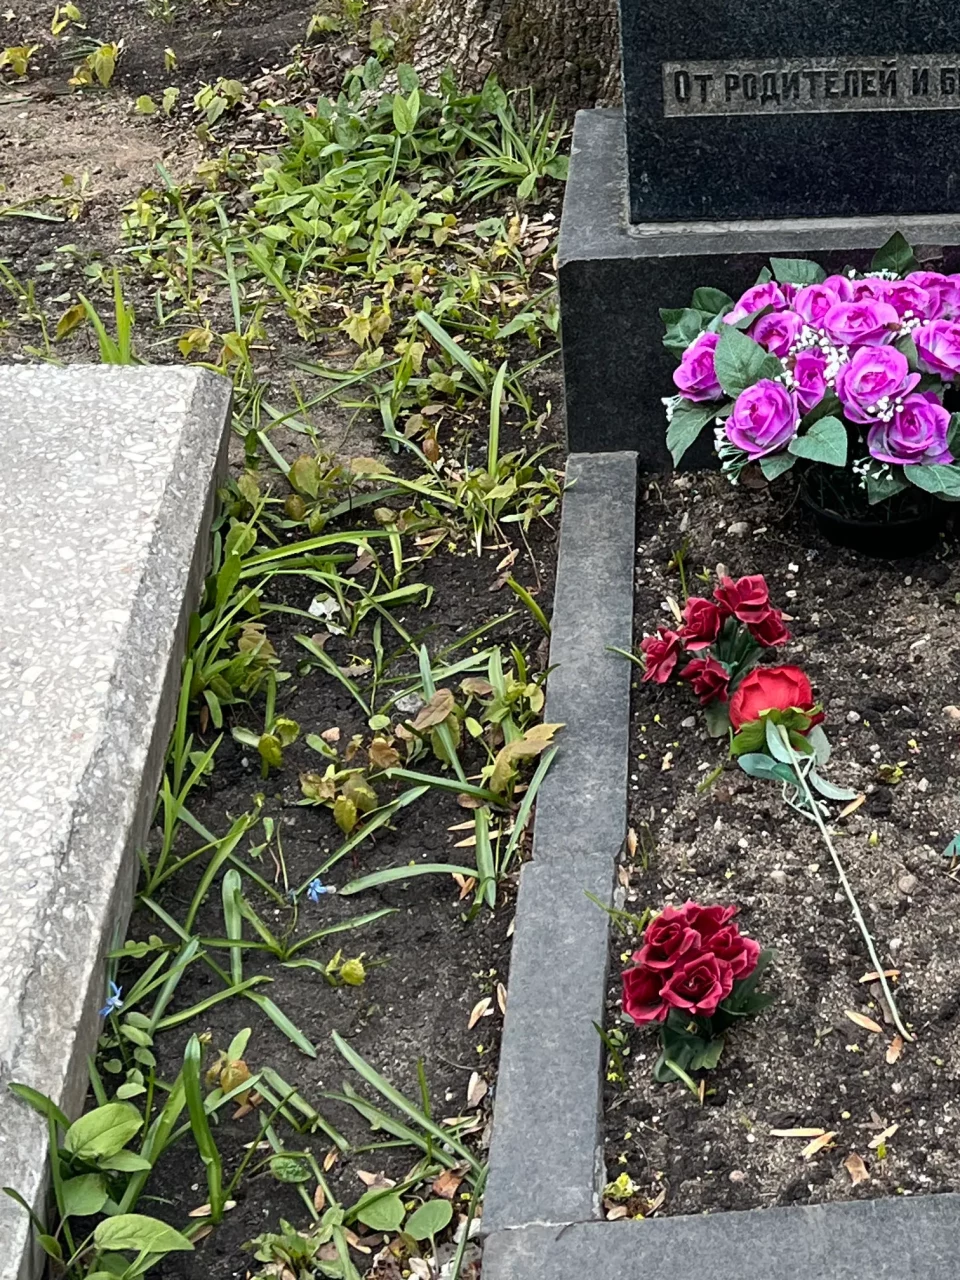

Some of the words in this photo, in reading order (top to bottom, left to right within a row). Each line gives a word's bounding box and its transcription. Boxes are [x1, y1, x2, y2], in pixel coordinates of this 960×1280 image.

[673, 69, 714, 105] ОТ
[725, 60, 898, 105] РОДИТЕЛЕЙ
[911, 66, 929, 96] И
